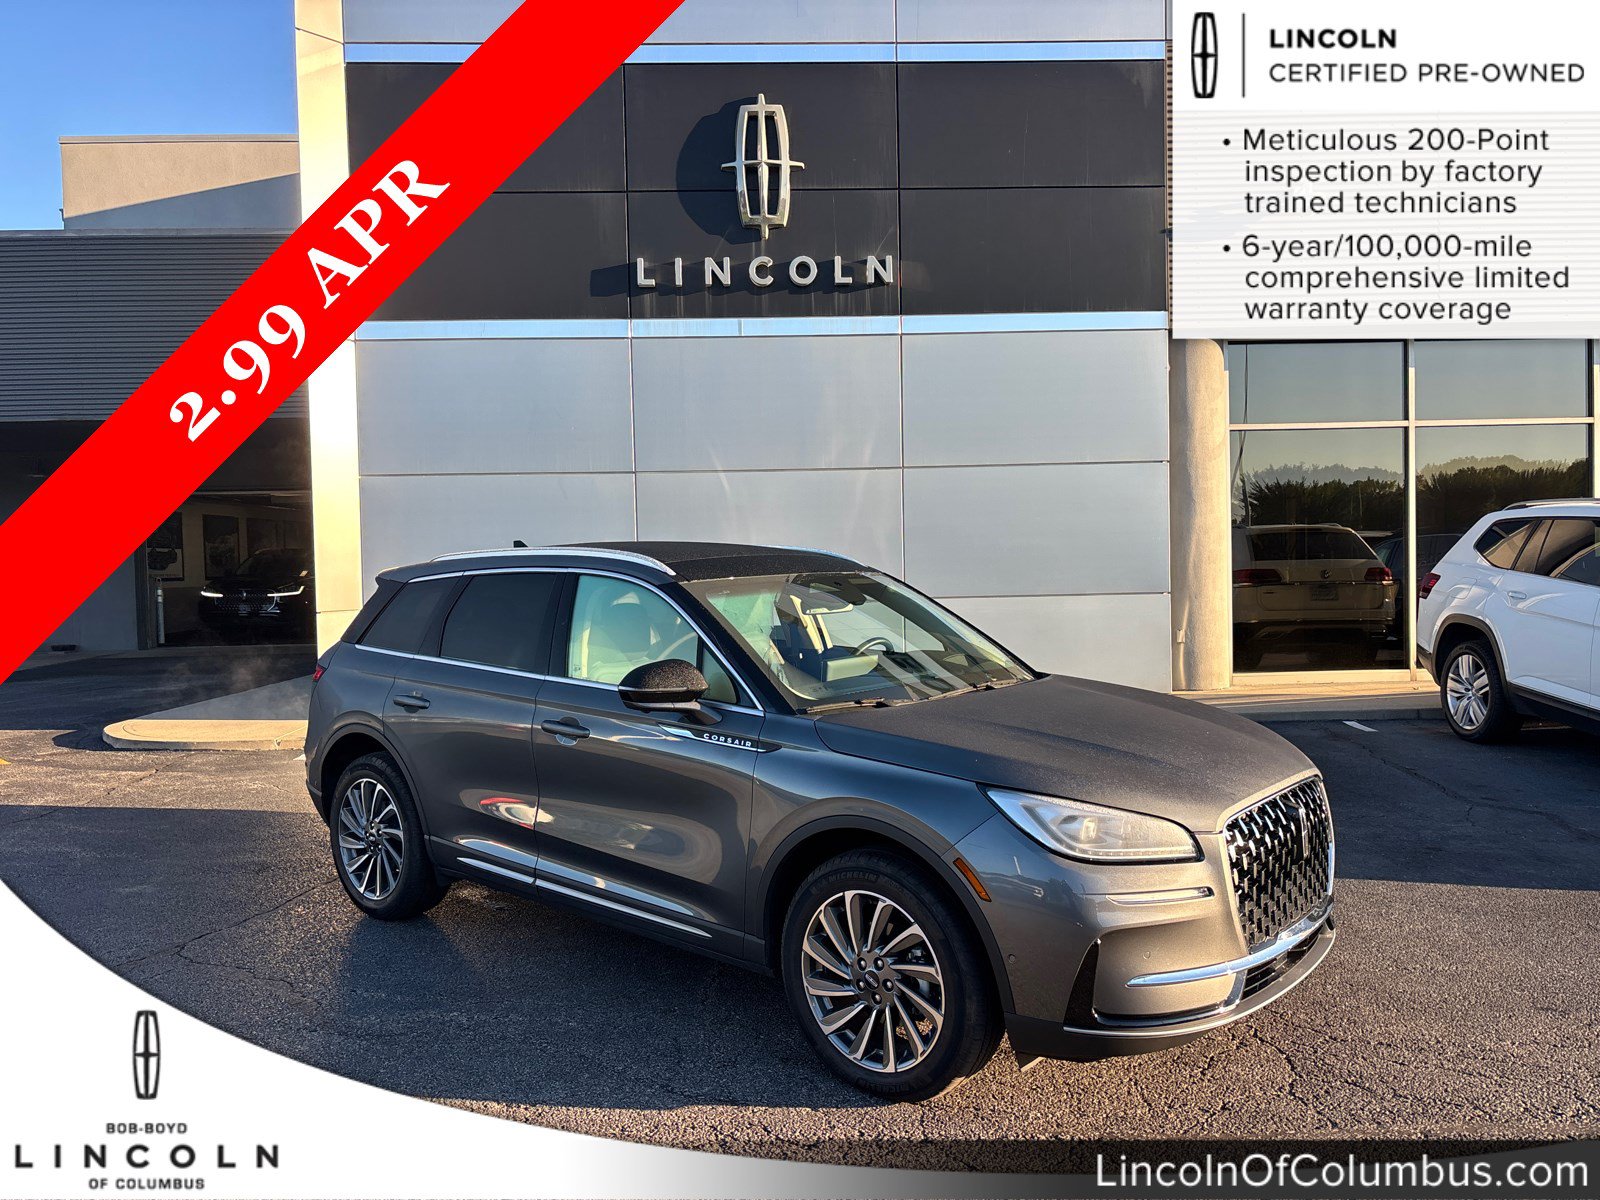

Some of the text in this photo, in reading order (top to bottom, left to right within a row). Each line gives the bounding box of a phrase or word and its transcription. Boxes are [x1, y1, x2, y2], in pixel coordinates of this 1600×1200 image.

[637, 255, 893, 287] LINCOLN
[703, 733, 752, 747] CORSAIR
[828, 871, 878, 881] MICHELIN
